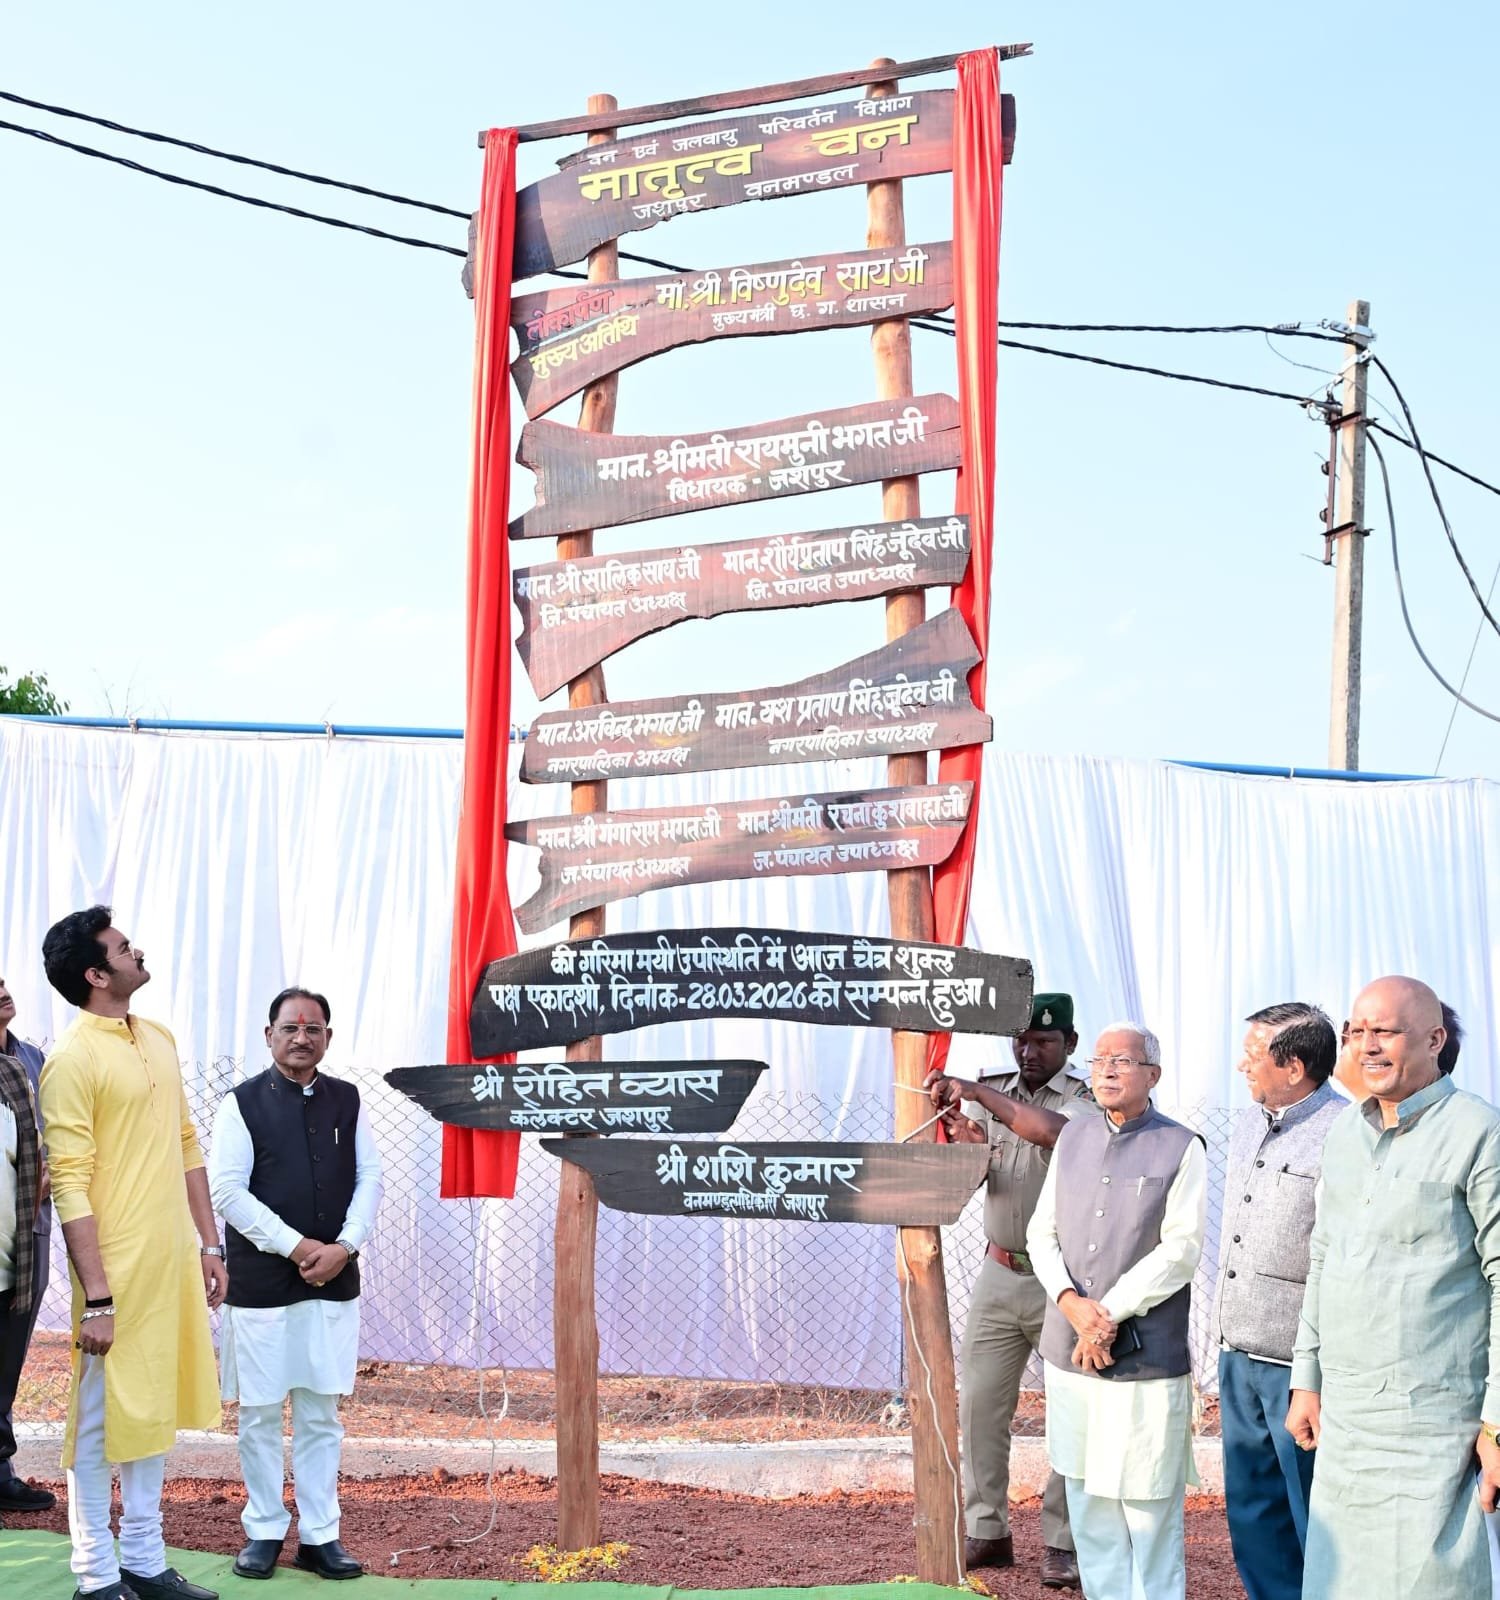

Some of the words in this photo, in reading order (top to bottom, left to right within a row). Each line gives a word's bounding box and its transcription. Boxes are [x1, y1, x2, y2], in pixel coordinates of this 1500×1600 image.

[587, 150, 618, 165] वन
[672, 128, 738, 152] जलवायु
[759, 109, 837, 135] परिवर्तन
[854, 96, 913, 117] विभाग
[577, 143, 764, 201] मातृत्व
[811, 114, 919, 158] वन
[632, 193, 707, 219] जशपुर
[744, 163, 859, 197] वनमण्डल
[728, 261, 826, 306] विष्णुदेव
[525, 290, 615, 340] लोकार्पण
[711, 303, 776, 331] मुख्यमंत्री
[846, 293, 907, 312] शासन
[653, 434, 736, 474] श्रीमती
[734, 420, 830, 469] रायमुनी
[666, 475, 747, 503] विधायक
[768, 460, 852, 491] जशपुर
[551, 944, 577, 977] की
[676, 933, 763, 975] उपस्थिति
[762, 935, 787, 974] में
[791, 945, 848, 974] आज
[852, 939, 893, 972] चैत्र
[895, 948, 956, 979] शुक्ल
[489, 984, 521, 1027] पक्ष
[470, 1065, 504, 1102] श्री
[512, 1064, 614, 1106] रोहित
[620, 1069, 723, 1103] व्यास
[509, 1103, 598, 1130] कलेक्टर
[599, 1106, 674, 1133] जशपुर
[656, 1144, 688, 1185] श्री
[693, 1145, 757, 1187] शशि
[760, 1156, 864, 1194] कुमार
[782, 1193, 829, 1222] जशपुर
